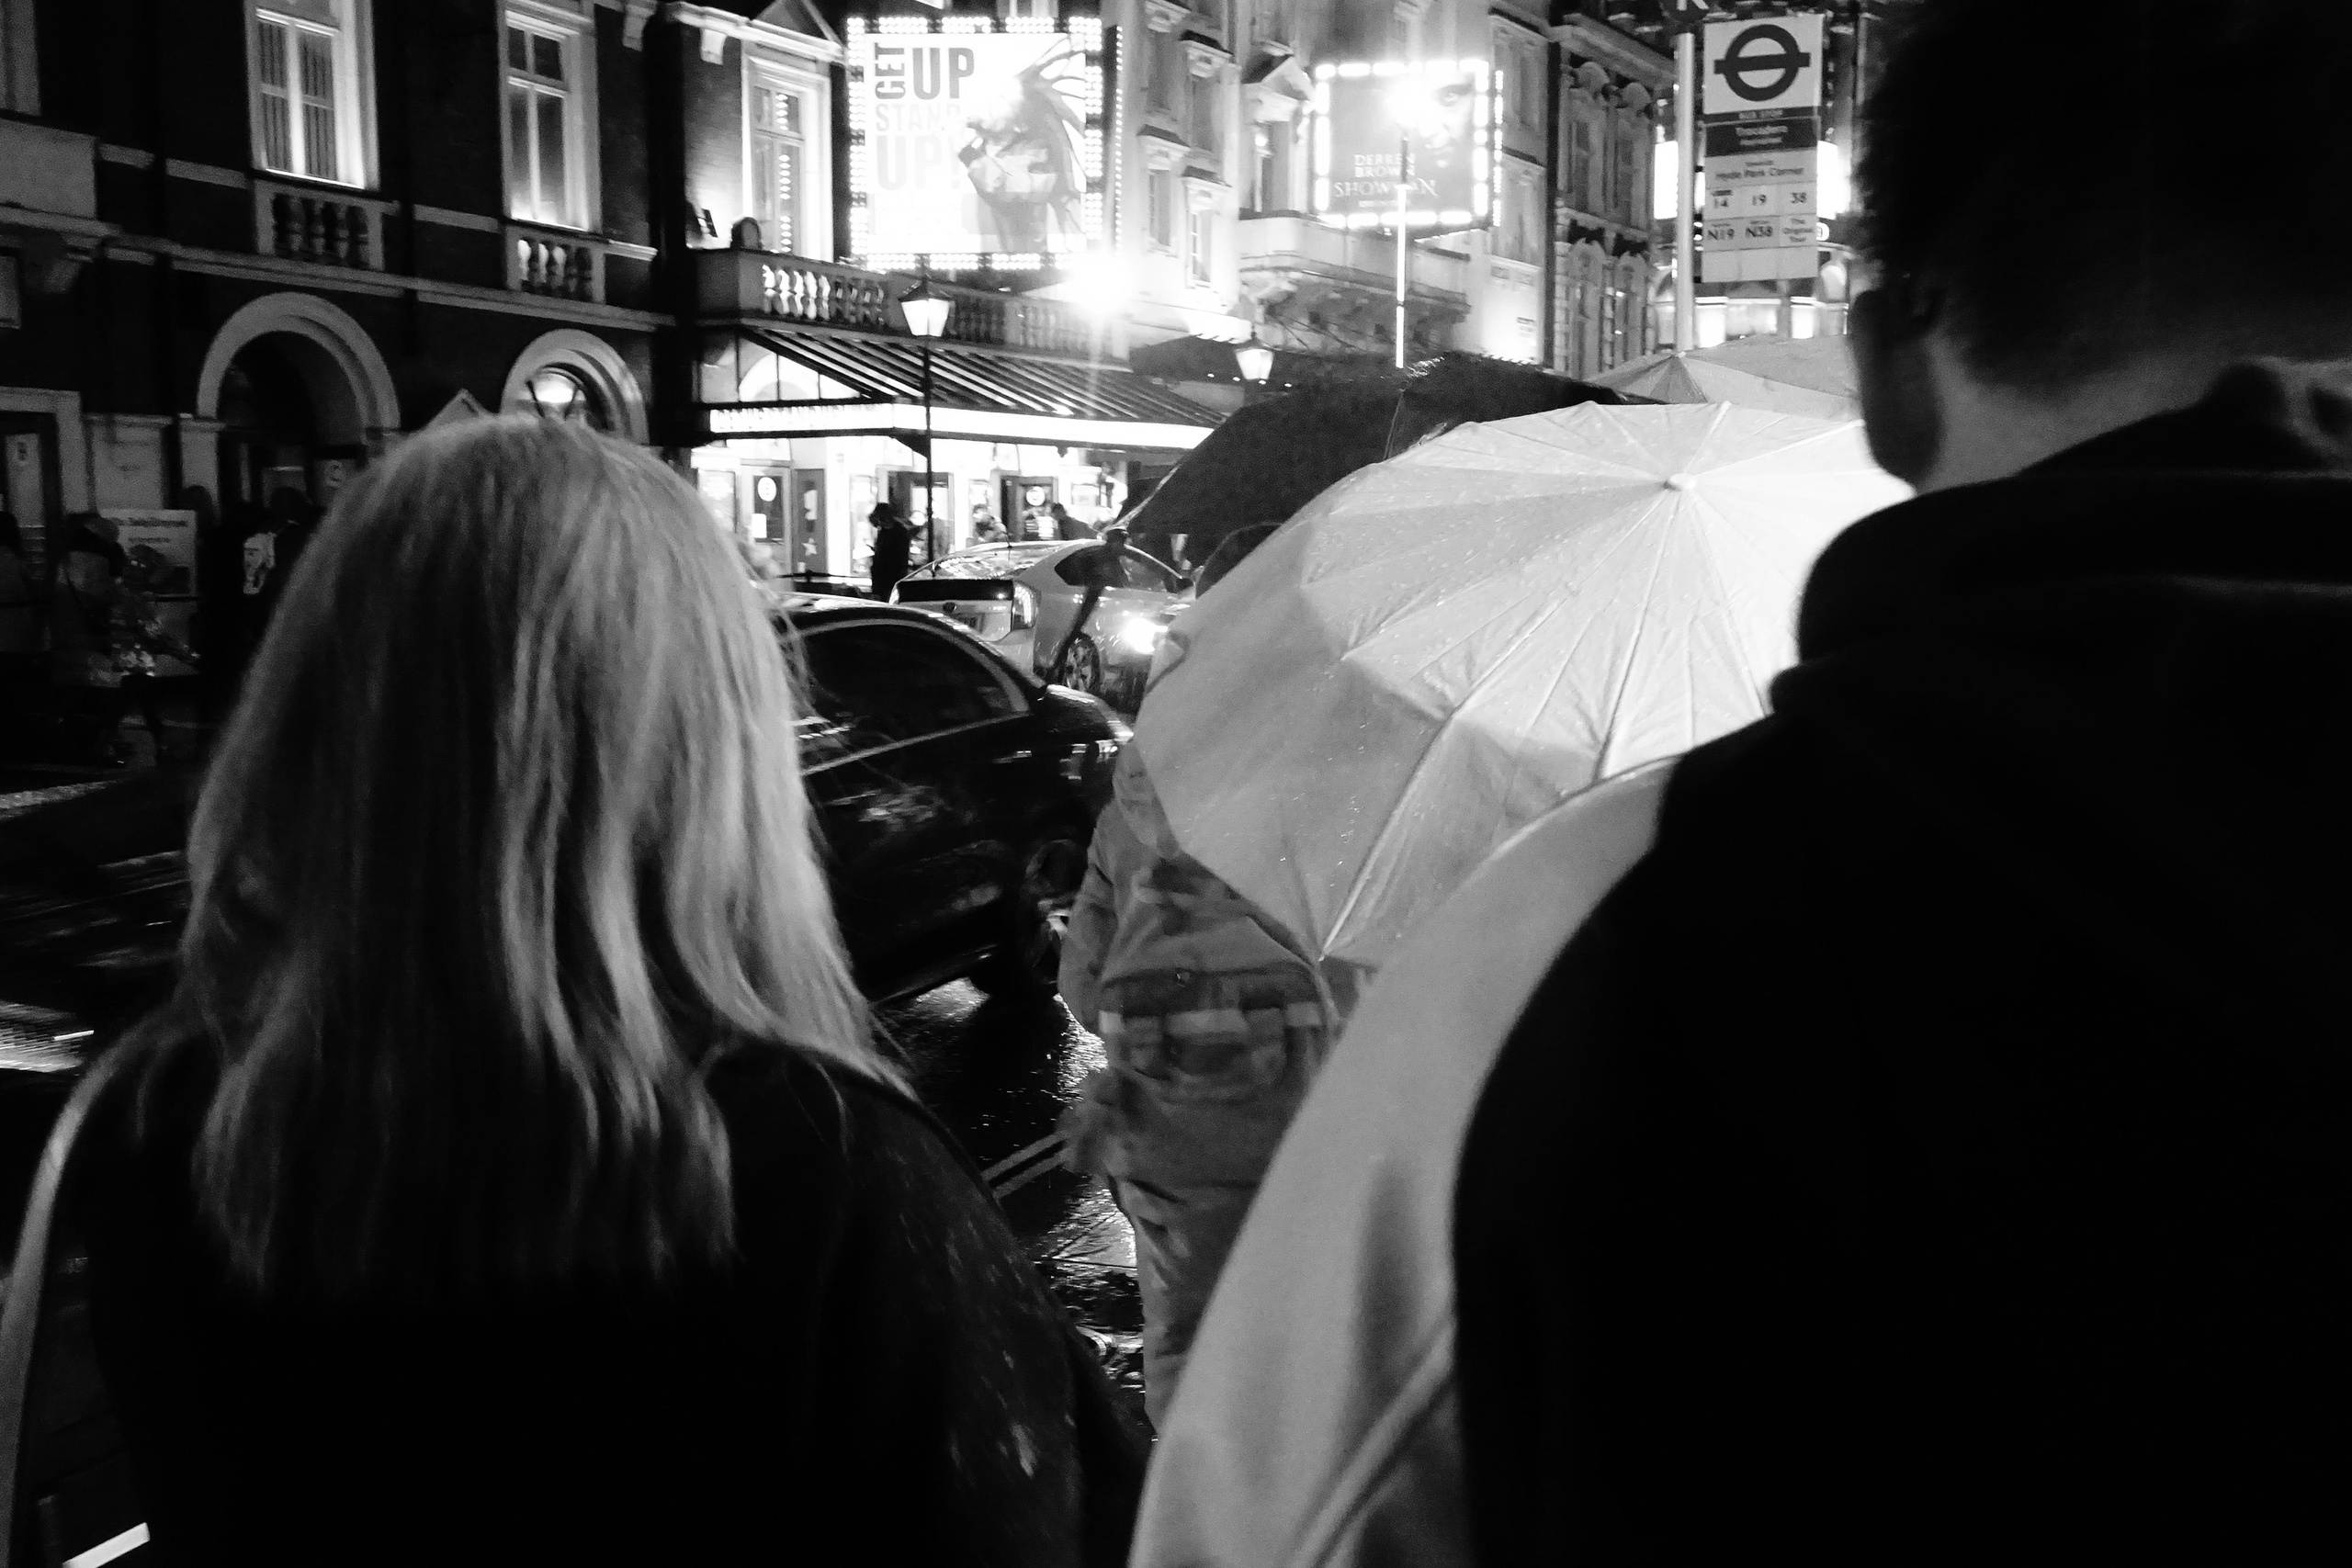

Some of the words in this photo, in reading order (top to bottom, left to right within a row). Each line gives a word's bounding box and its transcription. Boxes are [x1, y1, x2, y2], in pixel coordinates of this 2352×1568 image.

[875, 42, 906, 100] GET
[912, 47, 975, 100] UP
[876, 135, 961, 191] UP!
[1354, 153, 1416, 166] DERREN
[1713, 197, 1729, 209] 14
[1751, 194, 1767, 206] 19
[1791, 192, 1807, 204] 38
[1707, 228, 1735, 241] N19
